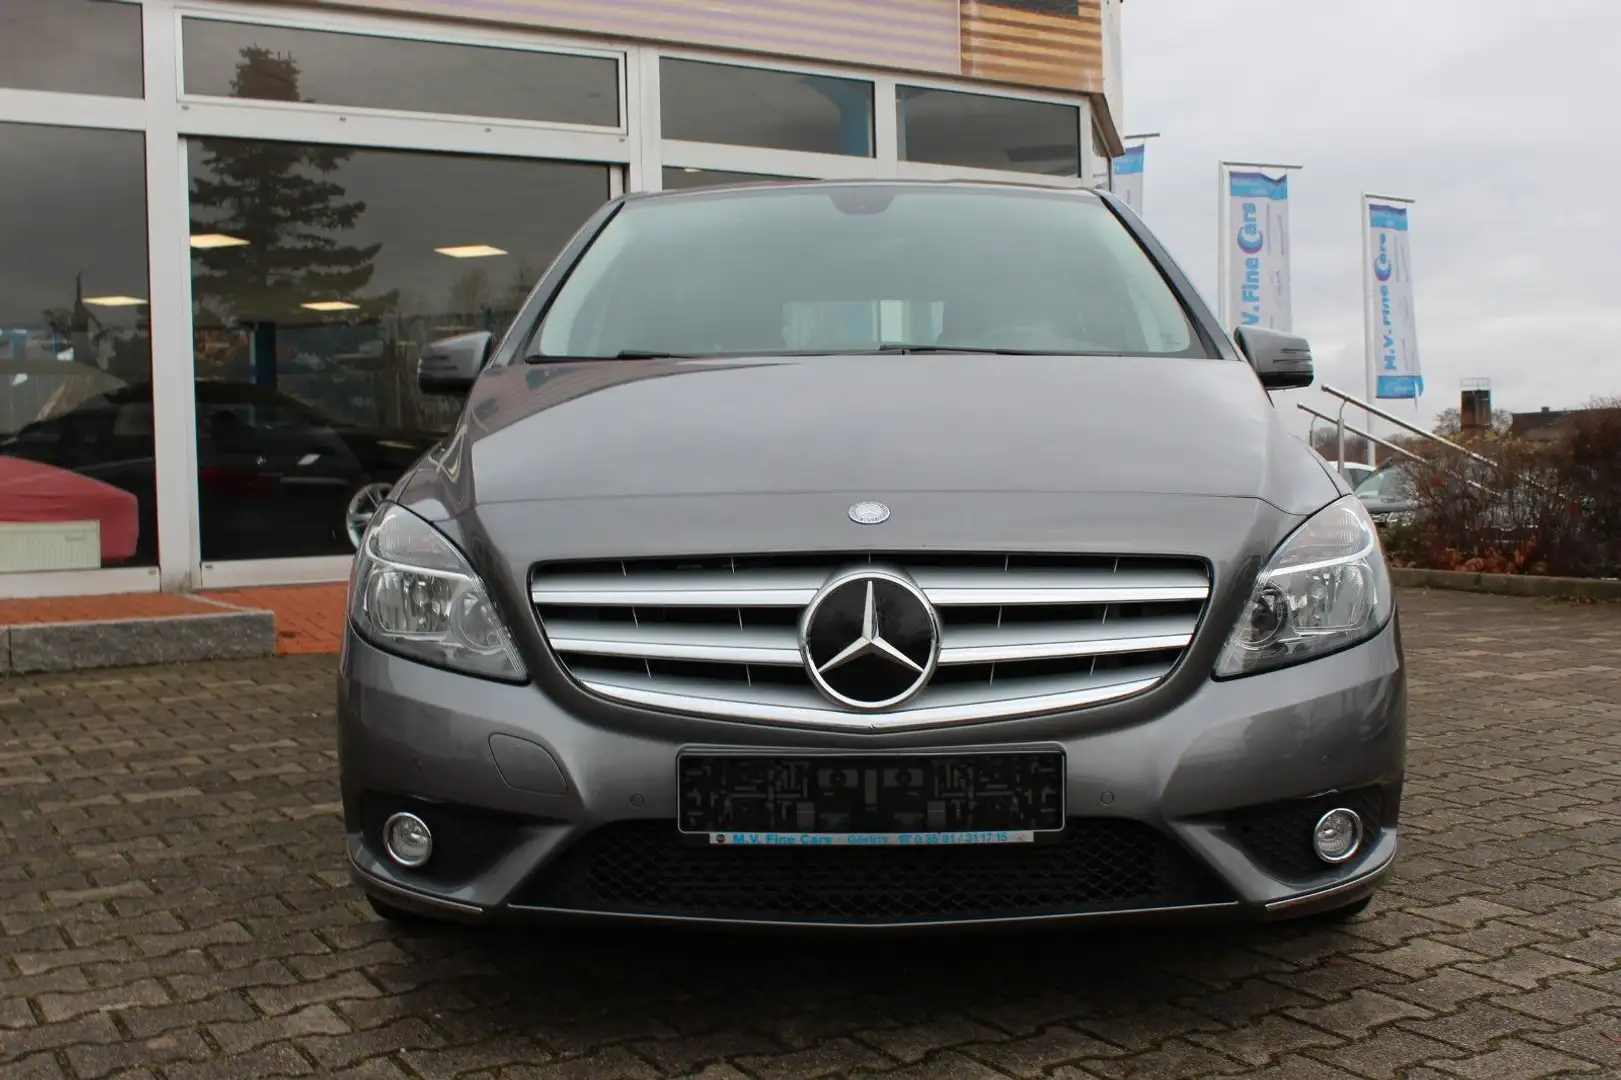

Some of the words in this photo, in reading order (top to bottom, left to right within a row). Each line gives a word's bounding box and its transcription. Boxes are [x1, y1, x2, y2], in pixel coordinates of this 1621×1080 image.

[1237, 202, 1264, 254] Cars
[1374, 233, 1392, 282] Cars
[765, 833, 795, 845] Fine
[800, 833, 832, 845] Cars
